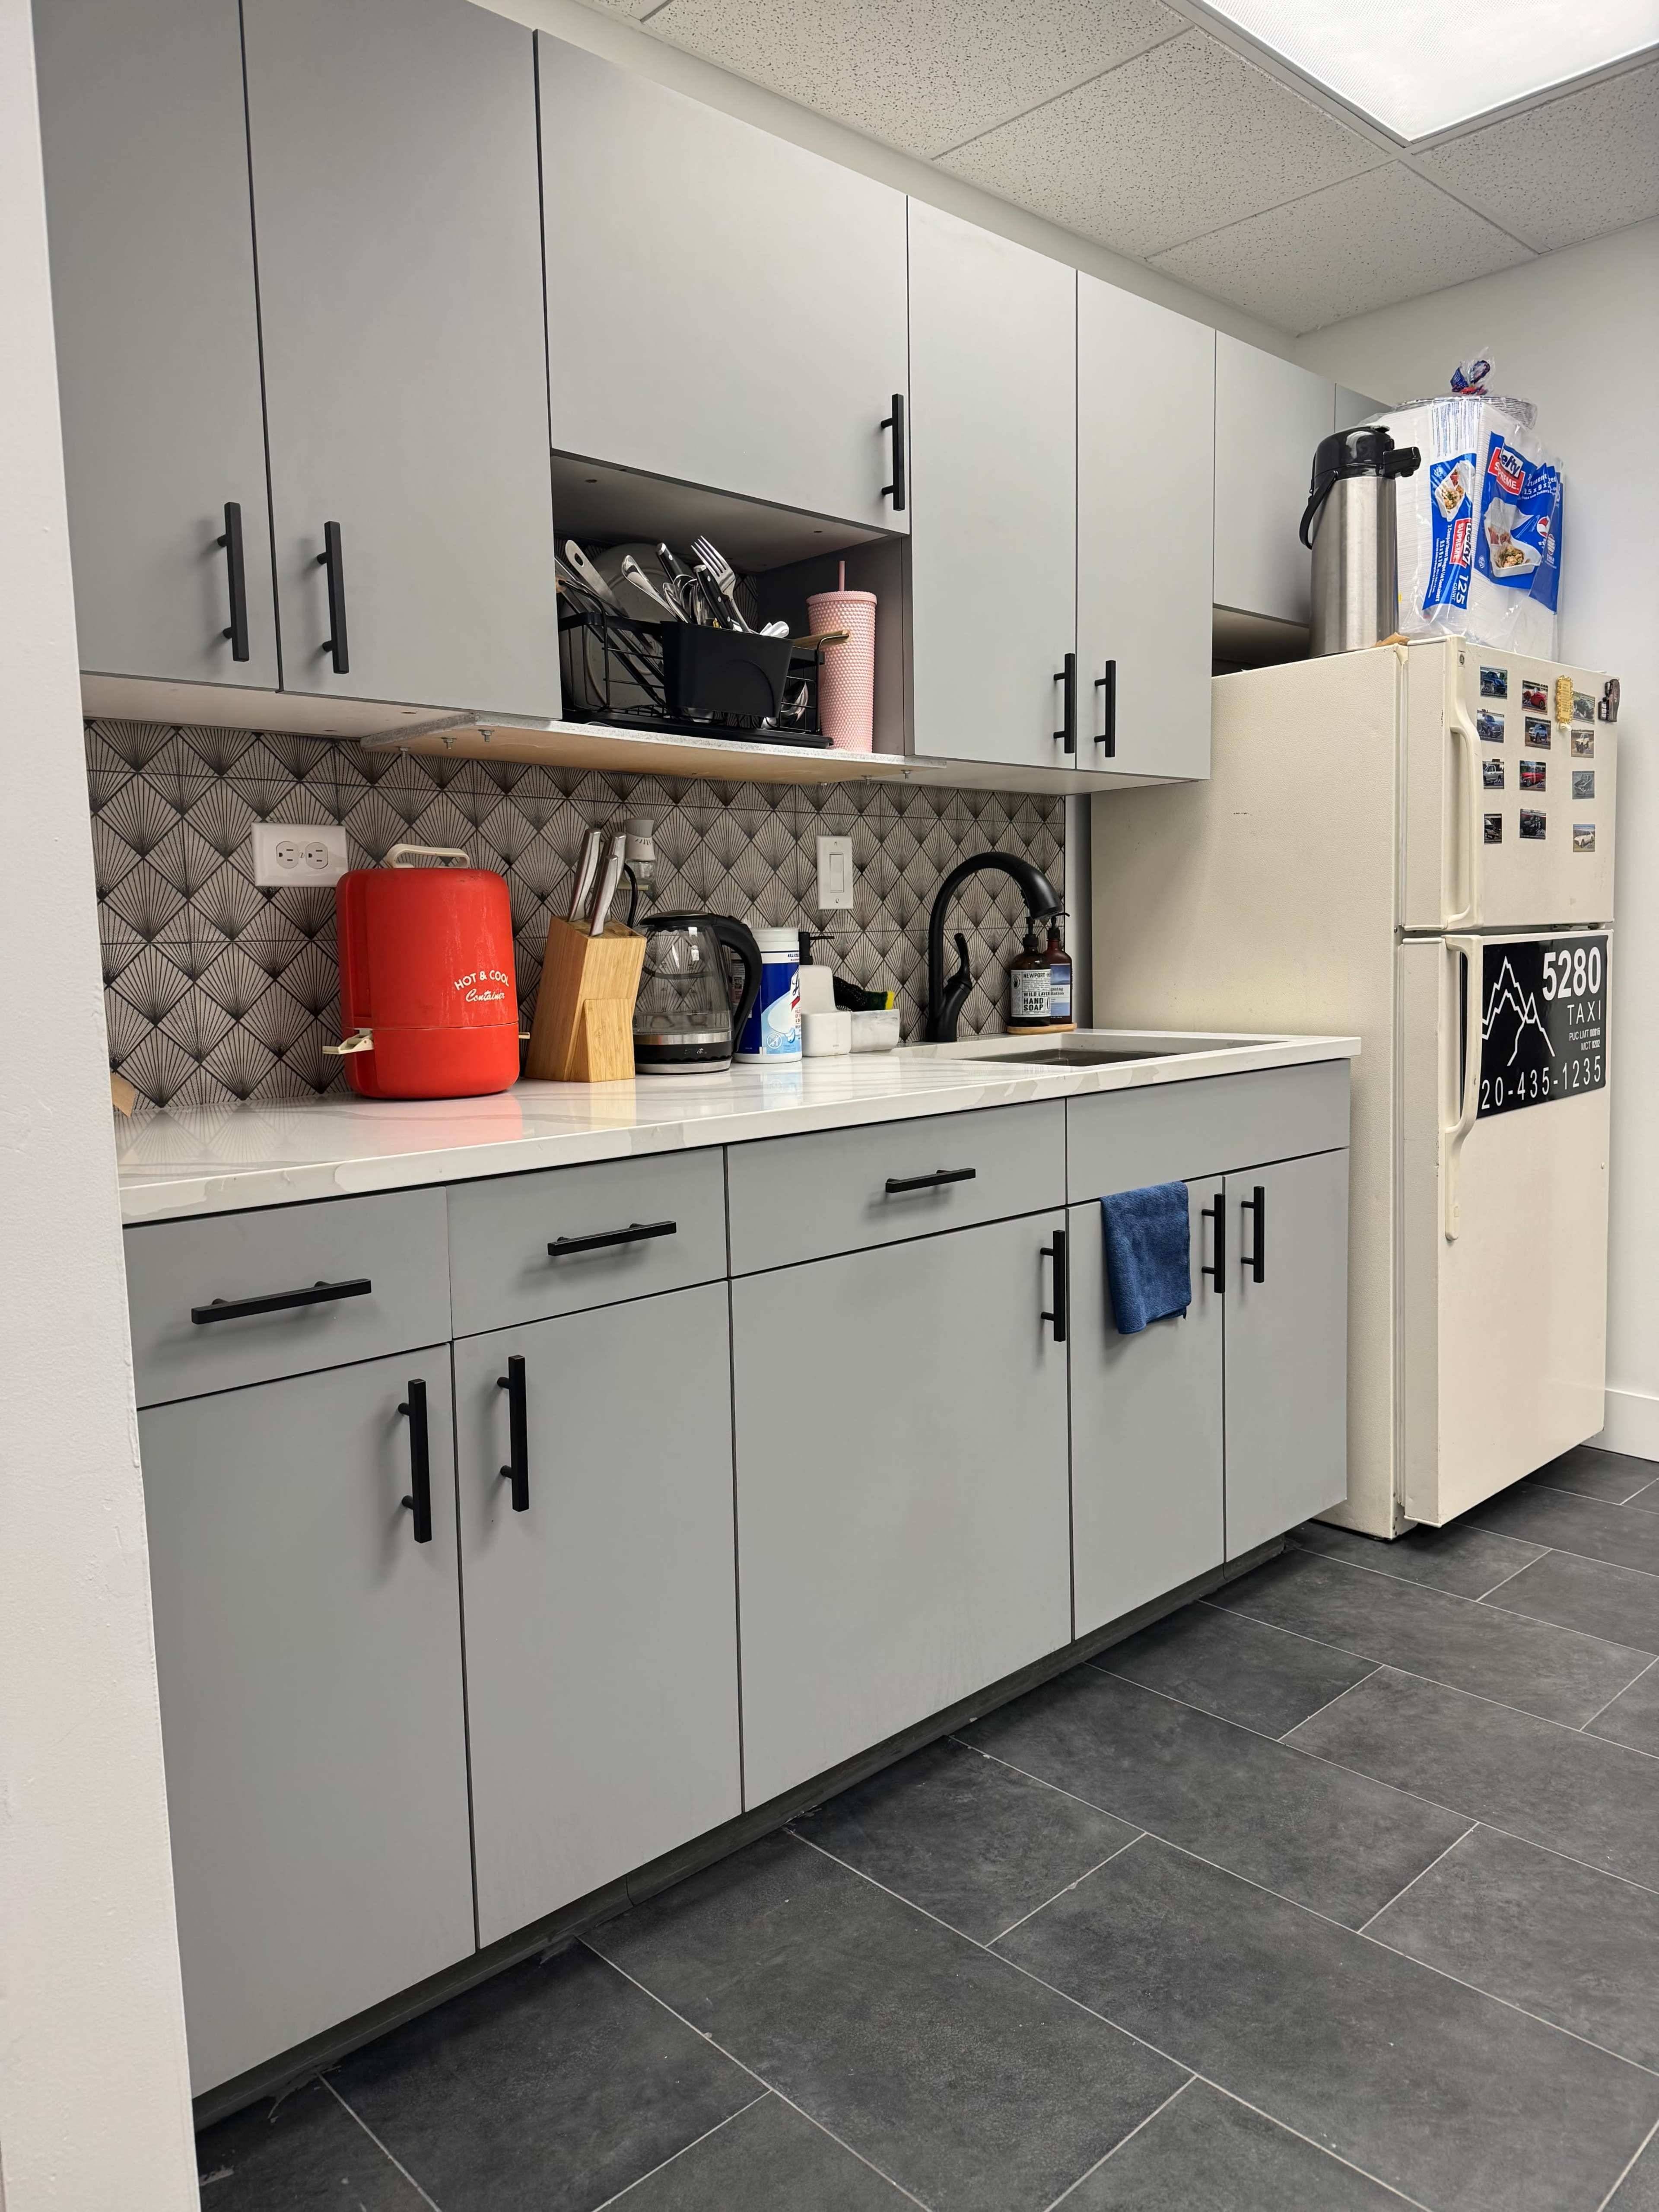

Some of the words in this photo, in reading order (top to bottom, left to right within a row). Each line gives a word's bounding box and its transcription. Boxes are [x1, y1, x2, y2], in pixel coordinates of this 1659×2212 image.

[1494, 461, 1517, 490] SPREME
[1501, 454, 1520, 476] efty
[1453, 522, 1464, 560] SUPREME
[1456, 575, 1468, 604] 125
[454, 973, 476, 990] HOT
[480, 971, 487, 981] &
[489, 970, 509, 987] COOL
[1542, 947, 1601, 1001] 5280
[466, 988, 505, 1002] Container
[1567, 1000, 1601, 1025] TAXI
[1569, 1031, 1579, 1041] PUC
[1580, 1029, 1589, 1039] LMT
[1581, 1041, 1591, 1050] MCT
[1481, 1056, 1601, 1110] 20-435-1235
